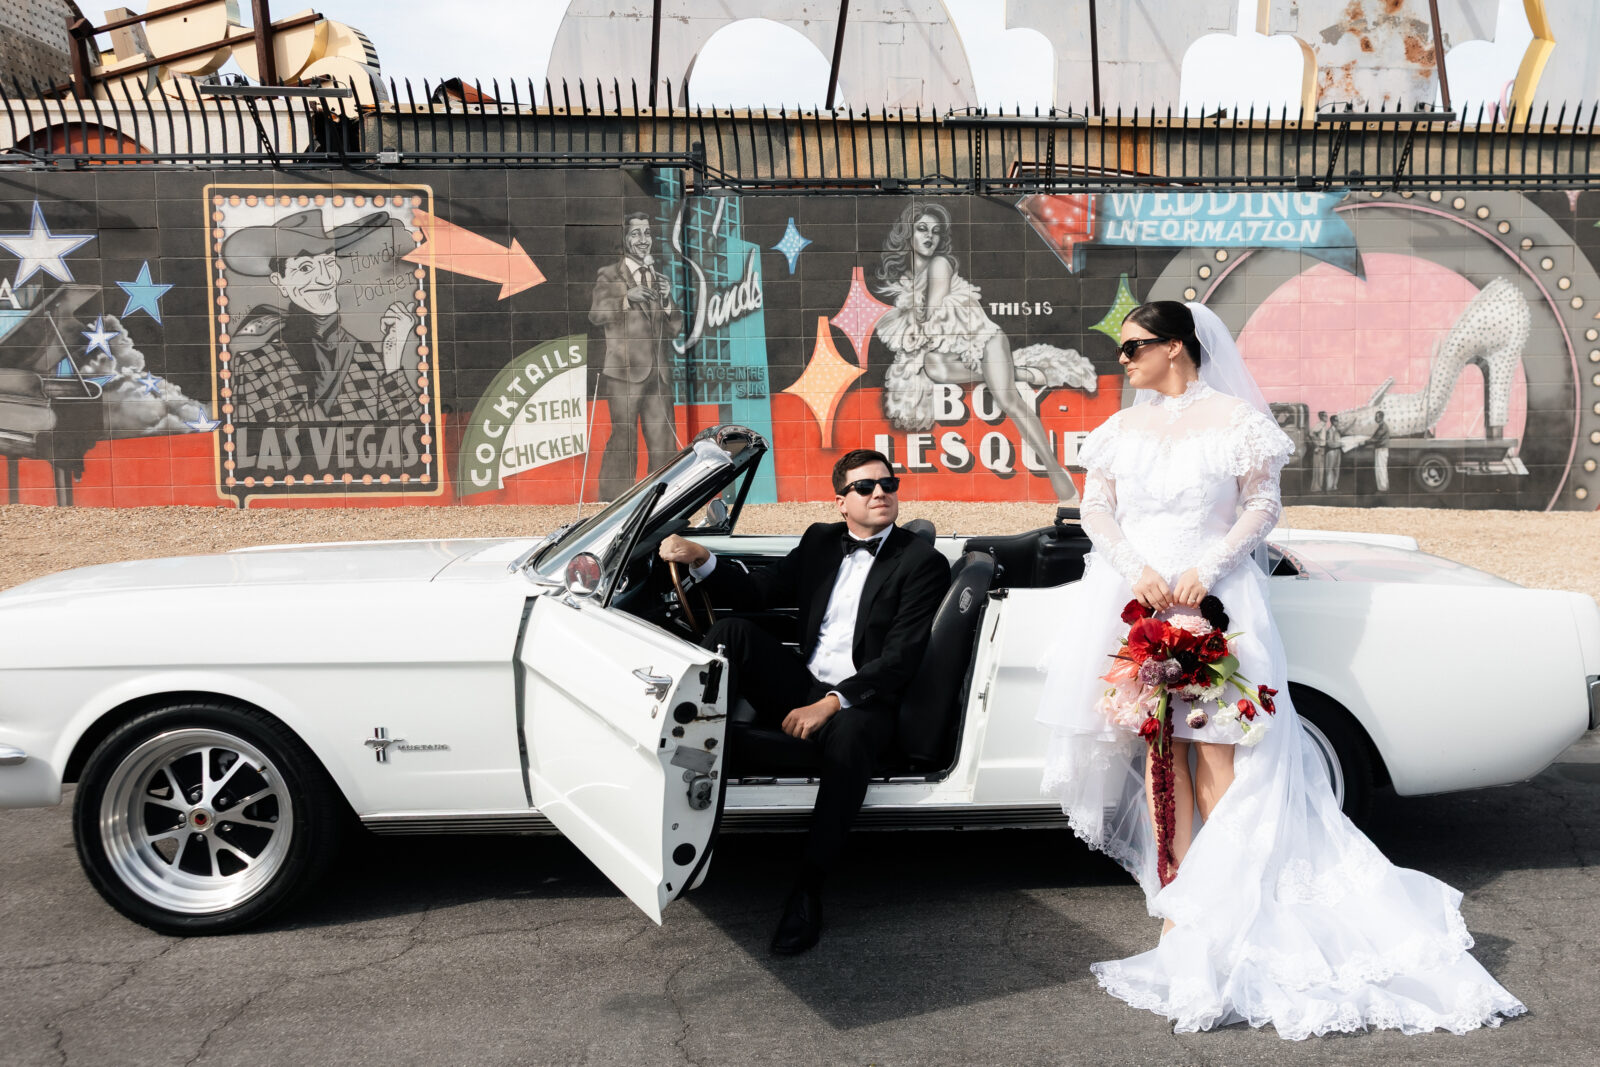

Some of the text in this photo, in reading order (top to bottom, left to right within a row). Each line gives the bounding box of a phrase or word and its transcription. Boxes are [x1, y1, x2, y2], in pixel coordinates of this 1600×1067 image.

[1111, 192, 1326, 219] WEDDING
[672, 196, 762, 355] Sands
[471, 345, 583, 487] COCKTAILS
[524, 397, 582, 424] STEAK
[236, 423, 419, 471] LAS VEGAS
[501, 433, 585, 469] CHICKEN
